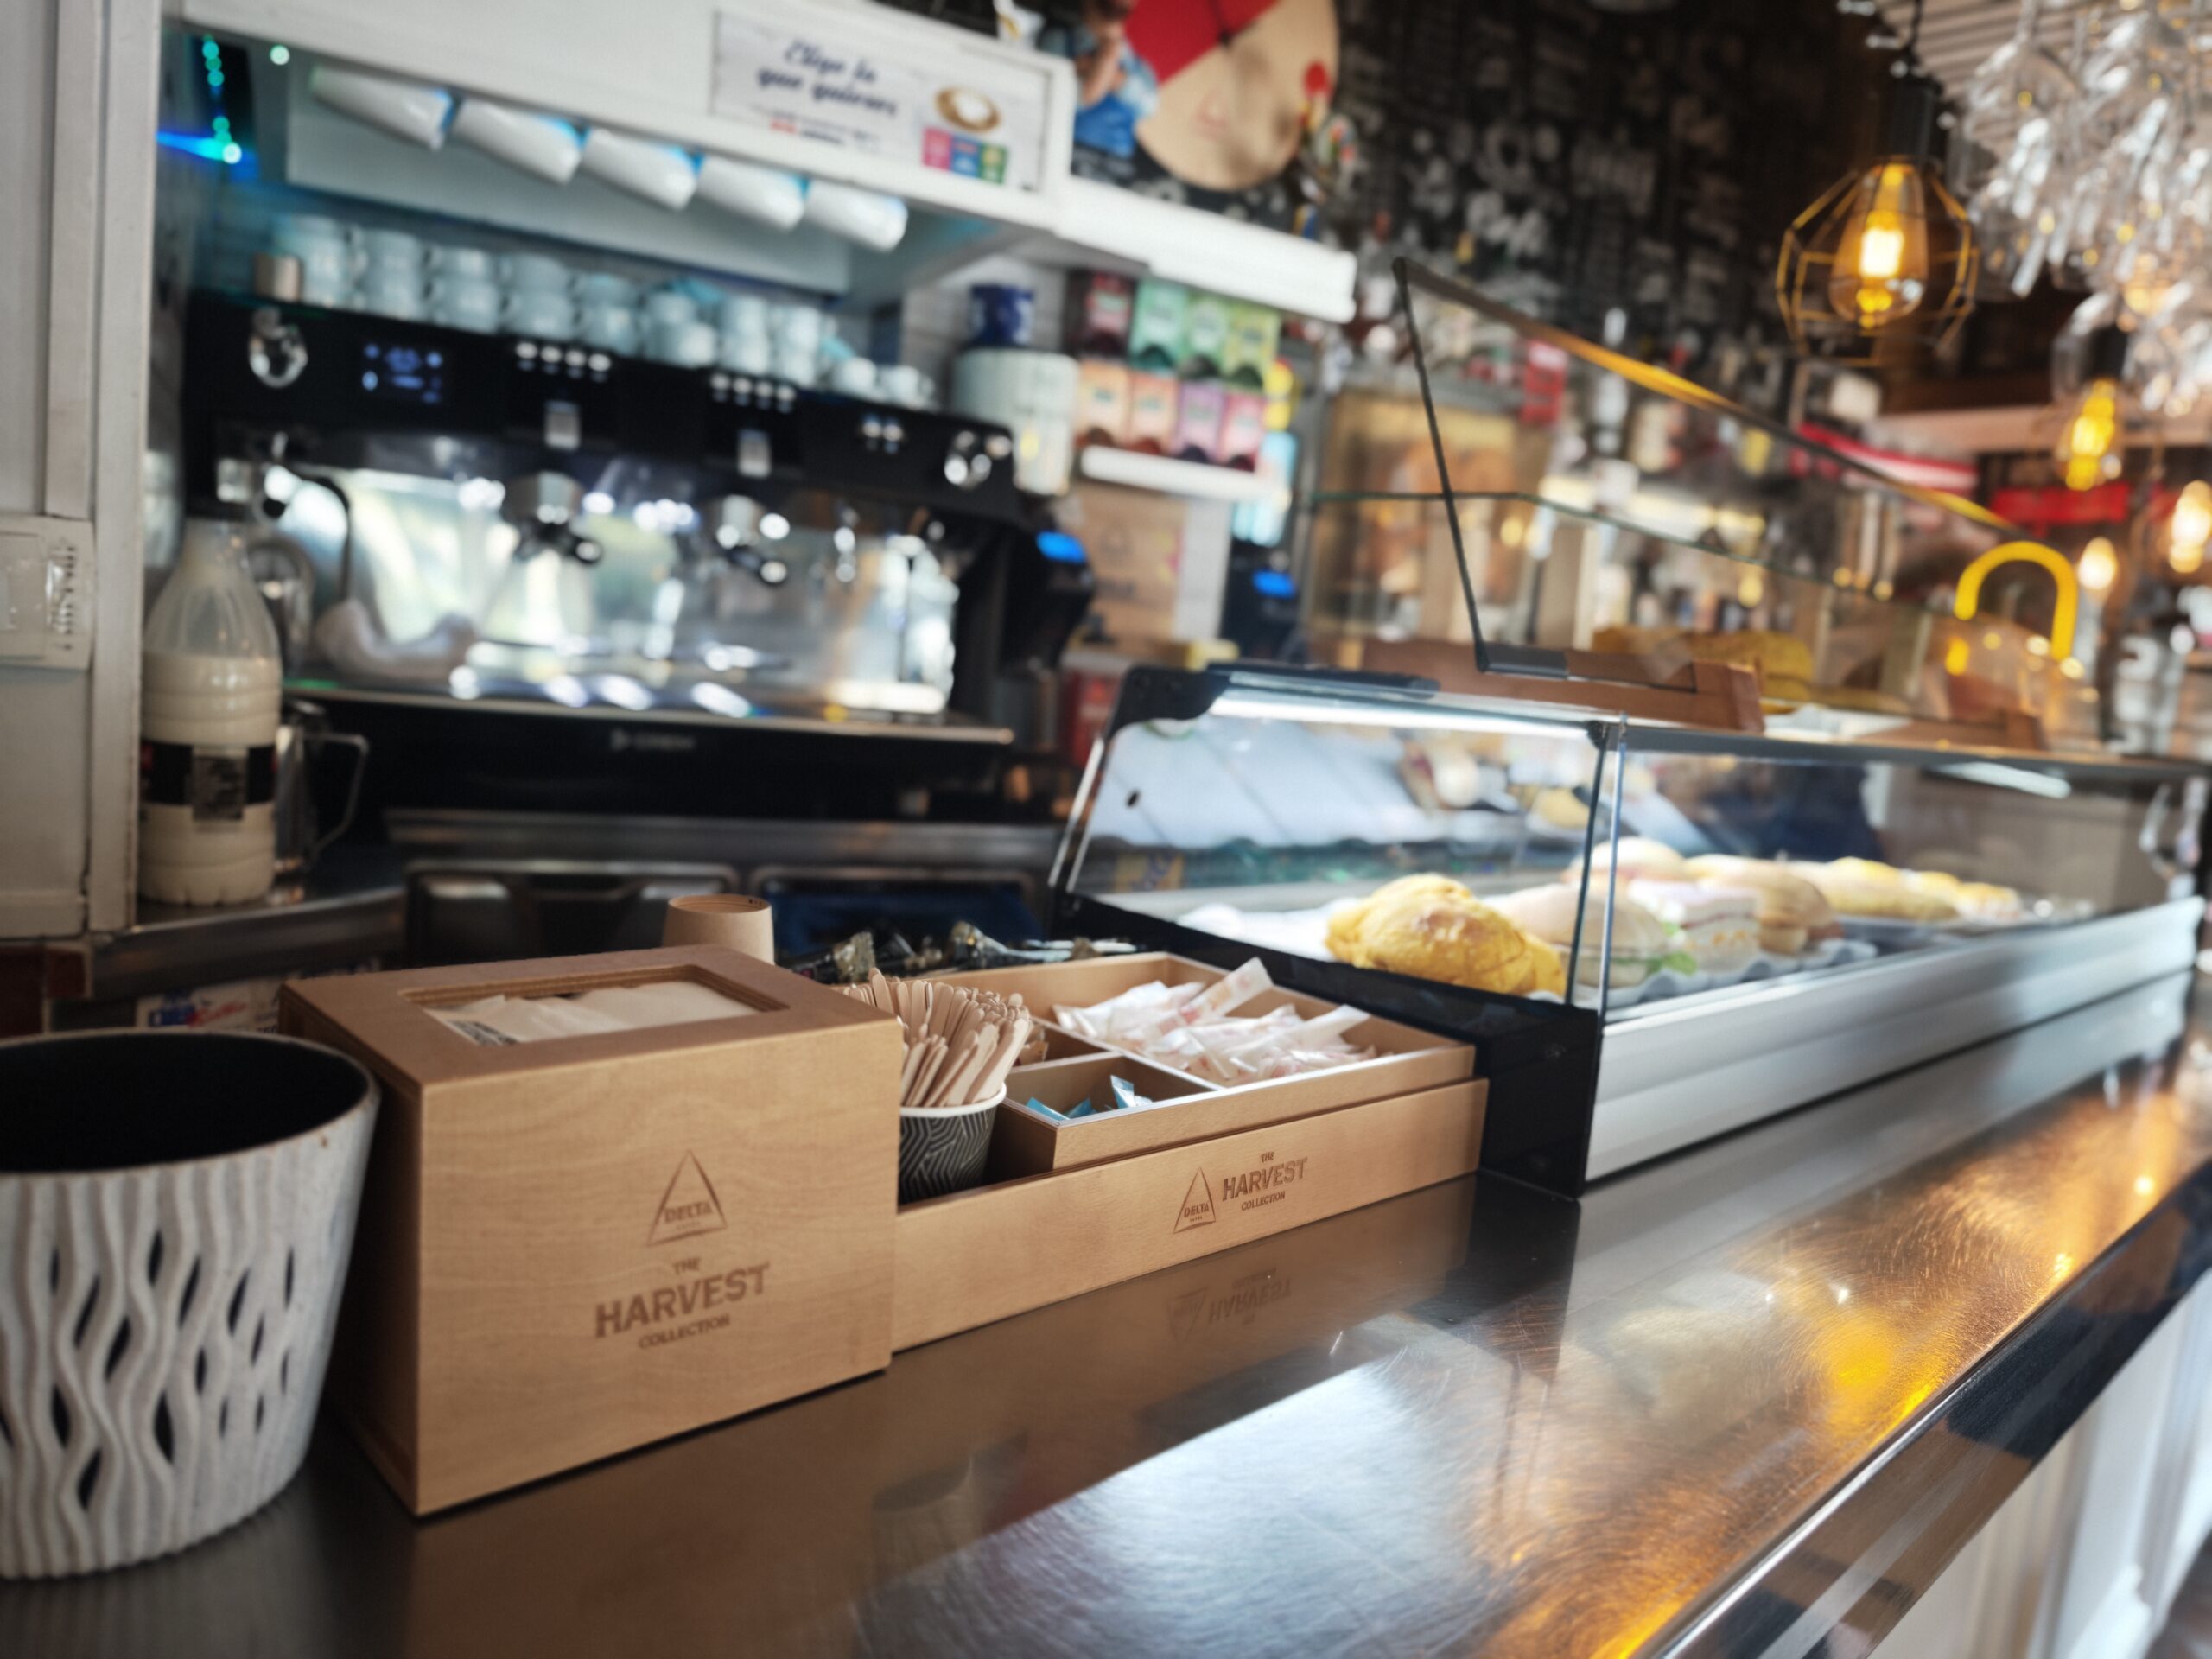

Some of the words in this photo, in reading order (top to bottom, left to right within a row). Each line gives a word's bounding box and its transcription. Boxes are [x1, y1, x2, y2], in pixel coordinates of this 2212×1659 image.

[1261, 1152, 1274, 1162] THE
[1222, 1158, 1307, 1201] HARVEST
[1184, 1202, 1210, 1218] DELTA
[1241, 1191, 1286, 1211] COLLECTION
[665, 1203, 711, 1223] DELTA
[673, 1258, 699, 1274] THE
[594, 1262, 770, 1338] HARVEST
[638, 1314, 730, 1348] COLLECTION
